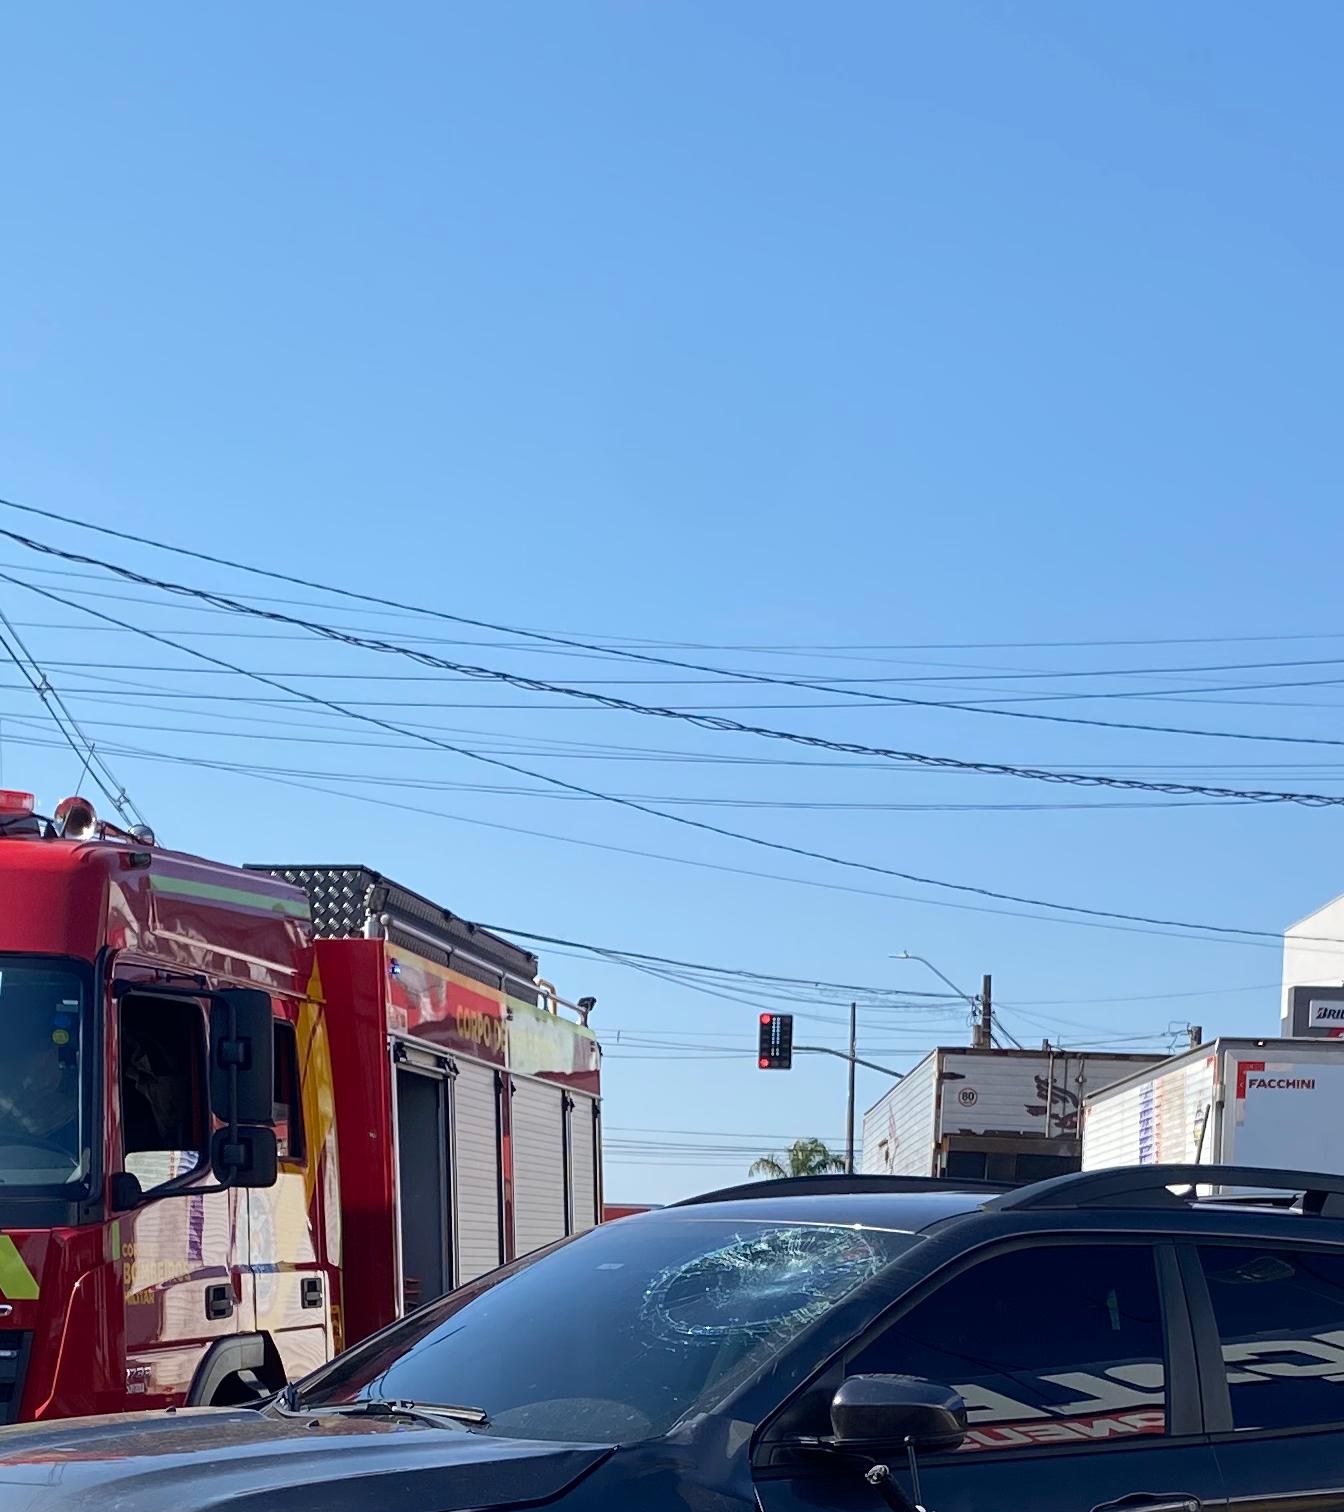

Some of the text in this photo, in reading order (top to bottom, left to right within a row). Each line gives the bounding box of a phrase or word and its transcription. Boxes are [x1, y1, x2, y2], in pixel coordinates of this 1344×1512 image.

[456, 1004, 492, 1049] CORPO
[1248, 1078, 1316, 1090] FACCHINI
[962, 1091, 975, 1101] 80
